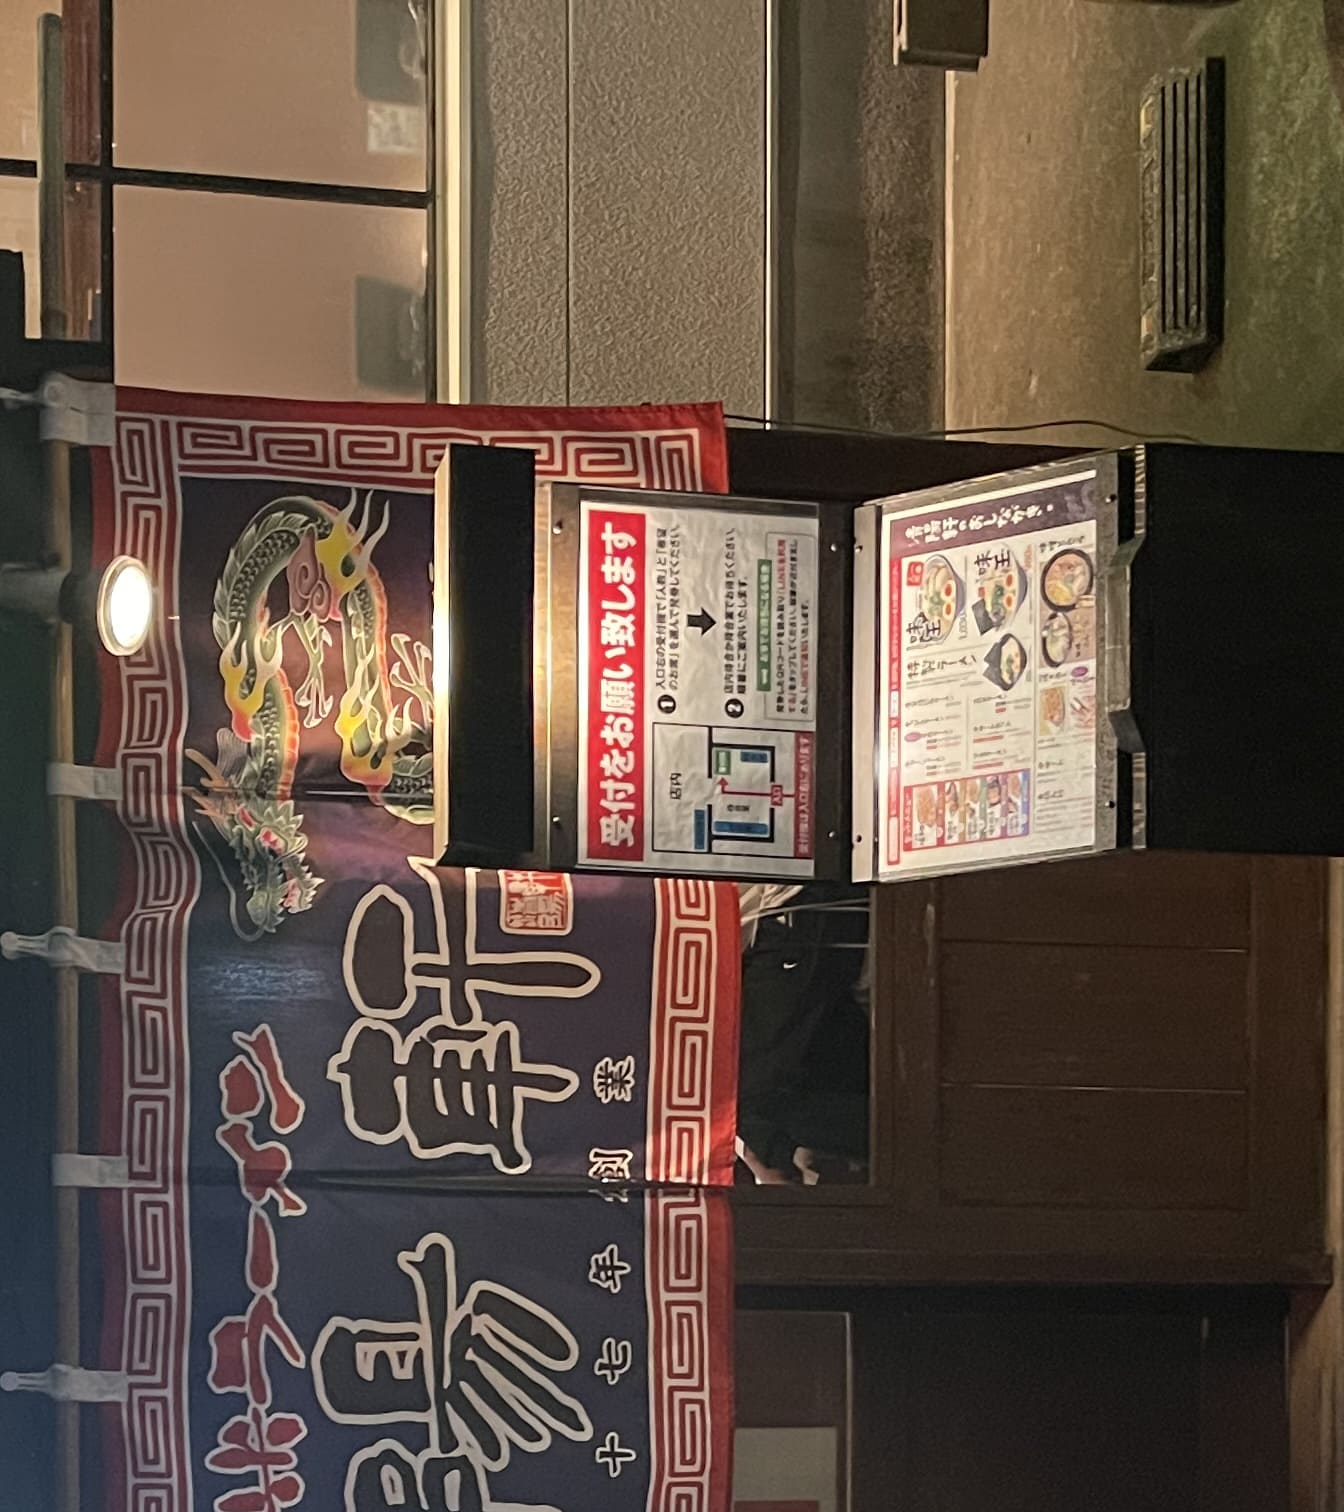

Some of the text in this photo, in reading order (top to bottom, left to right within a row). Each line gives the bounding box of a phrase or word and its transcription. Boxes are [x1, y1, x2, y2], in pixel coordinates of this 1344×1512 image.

[599, 521, 638, 848] 受付をお願い致します
[668, 772, 683, 801] 店内
